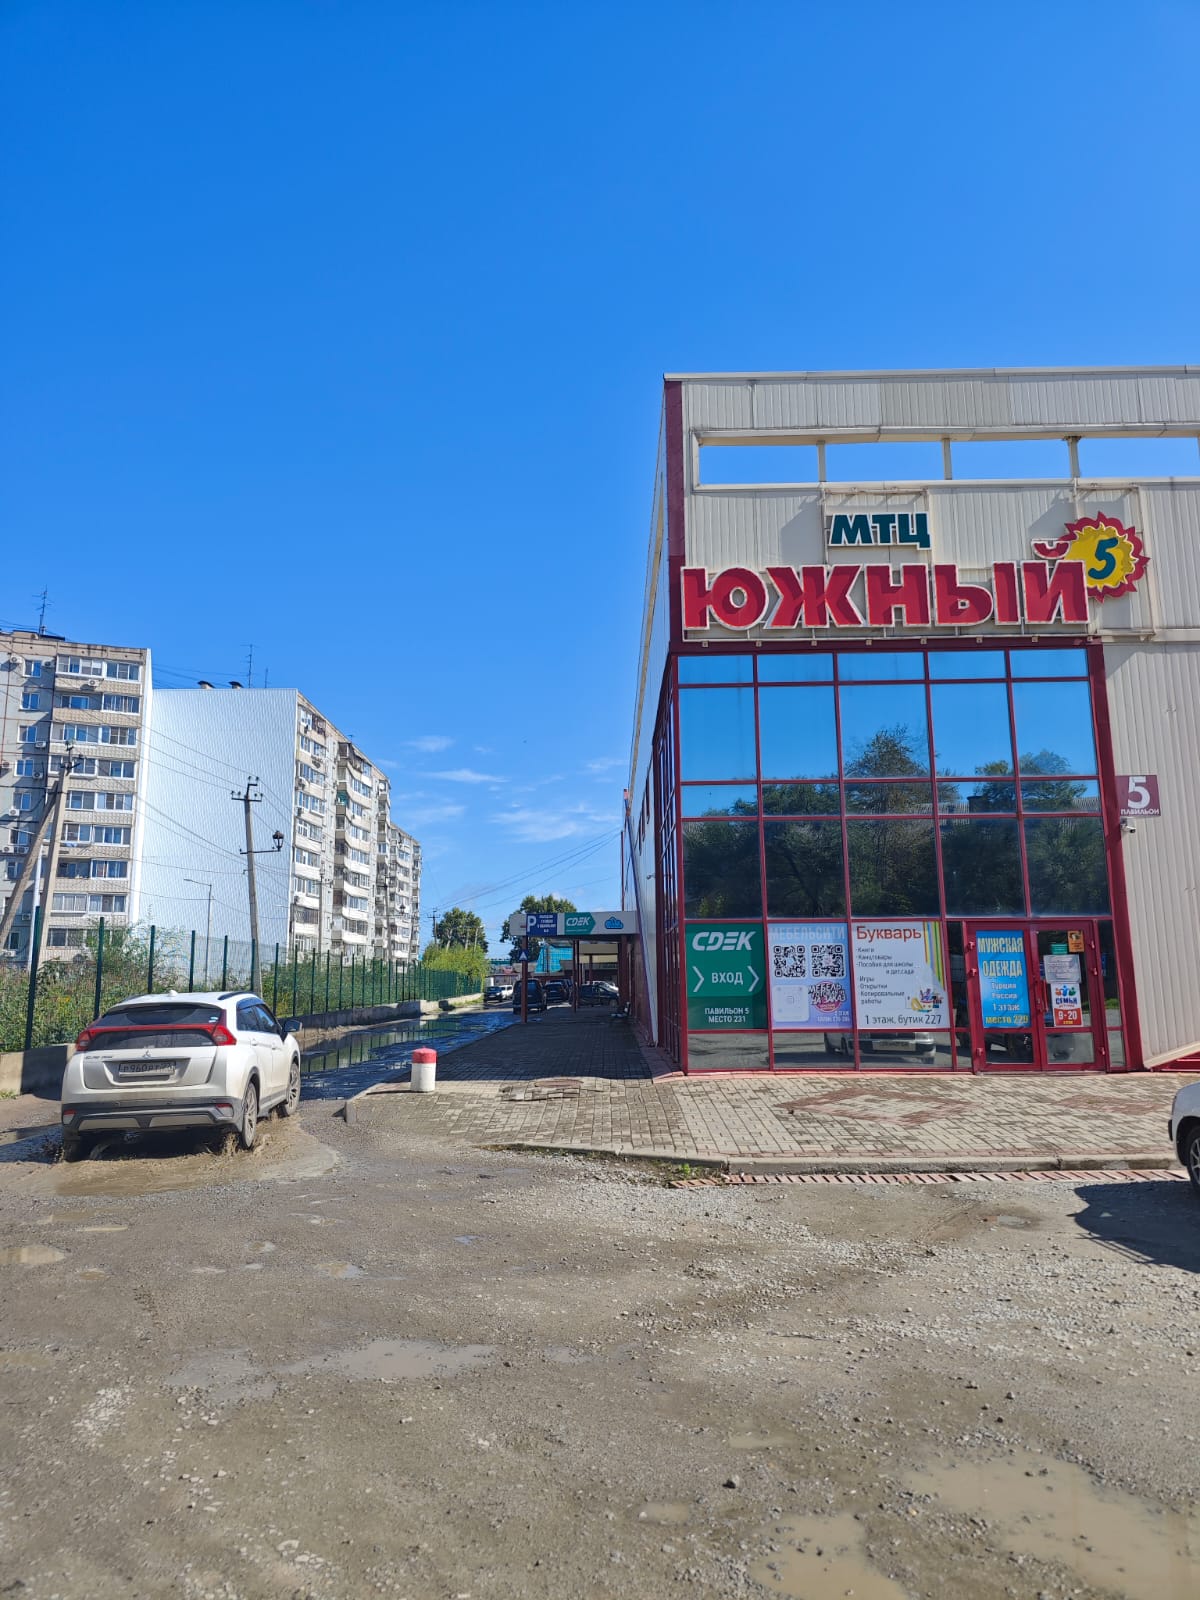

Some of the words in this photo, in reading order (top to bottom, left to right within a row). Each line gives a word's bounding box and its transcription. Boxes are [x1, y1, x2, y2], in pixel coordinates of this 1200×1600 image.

[829, 512, 930, 550] МТЦ
[1087, 537, 1117, 580] 5
[681, 540, 1090, 630] ЮЖНЫЙ
[1128, 776, 1150, 809] 5
[1120, 808, 1160, 816] ПАВИЛЬОН
[526, 915, 537, 932] P
[856, 926, 922, 943] Букварь
[978, 937, 1023, 953] МУЖСКАЯ
[983, 960, 1023, 978] ОДЕЖДА
[712, 972, 743, 985] ВХОД
[734, 1015, 746, 1023] 231
[865, 1015, 869, 1024] 1
[898, 1015, 924, 1026] бутик
[925, 1014, 942, 1025] 227
[985, 1016, 1012, 1024] место
